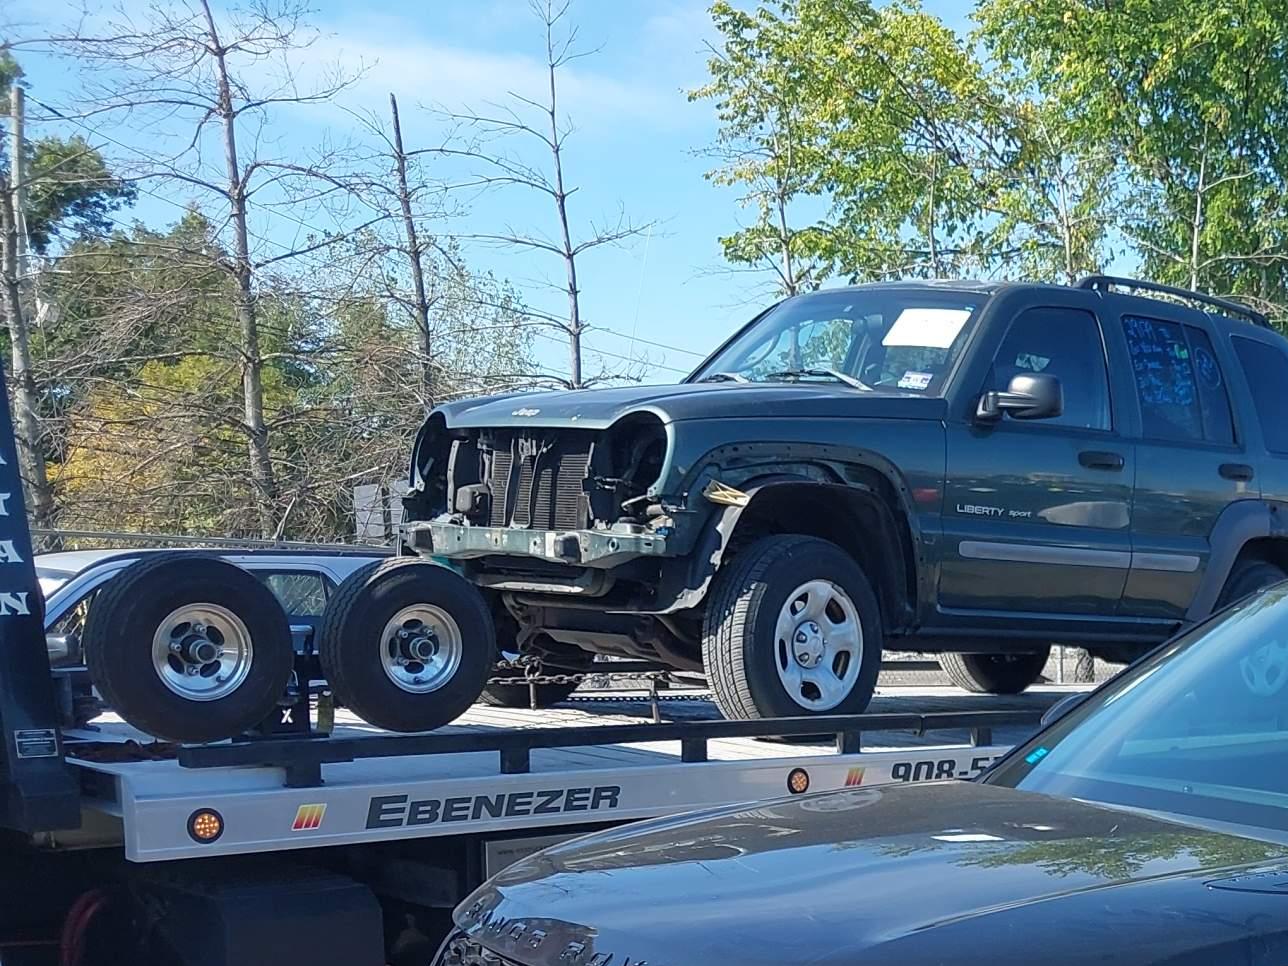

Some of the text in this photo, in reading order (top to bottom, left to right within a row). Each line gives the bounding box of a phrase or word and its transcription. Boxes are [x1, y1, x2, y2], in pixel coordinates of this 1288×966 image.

[956, 503, 1032, 518] LIBERTY sport
[365, 785, 622, 830] EBENEZER
